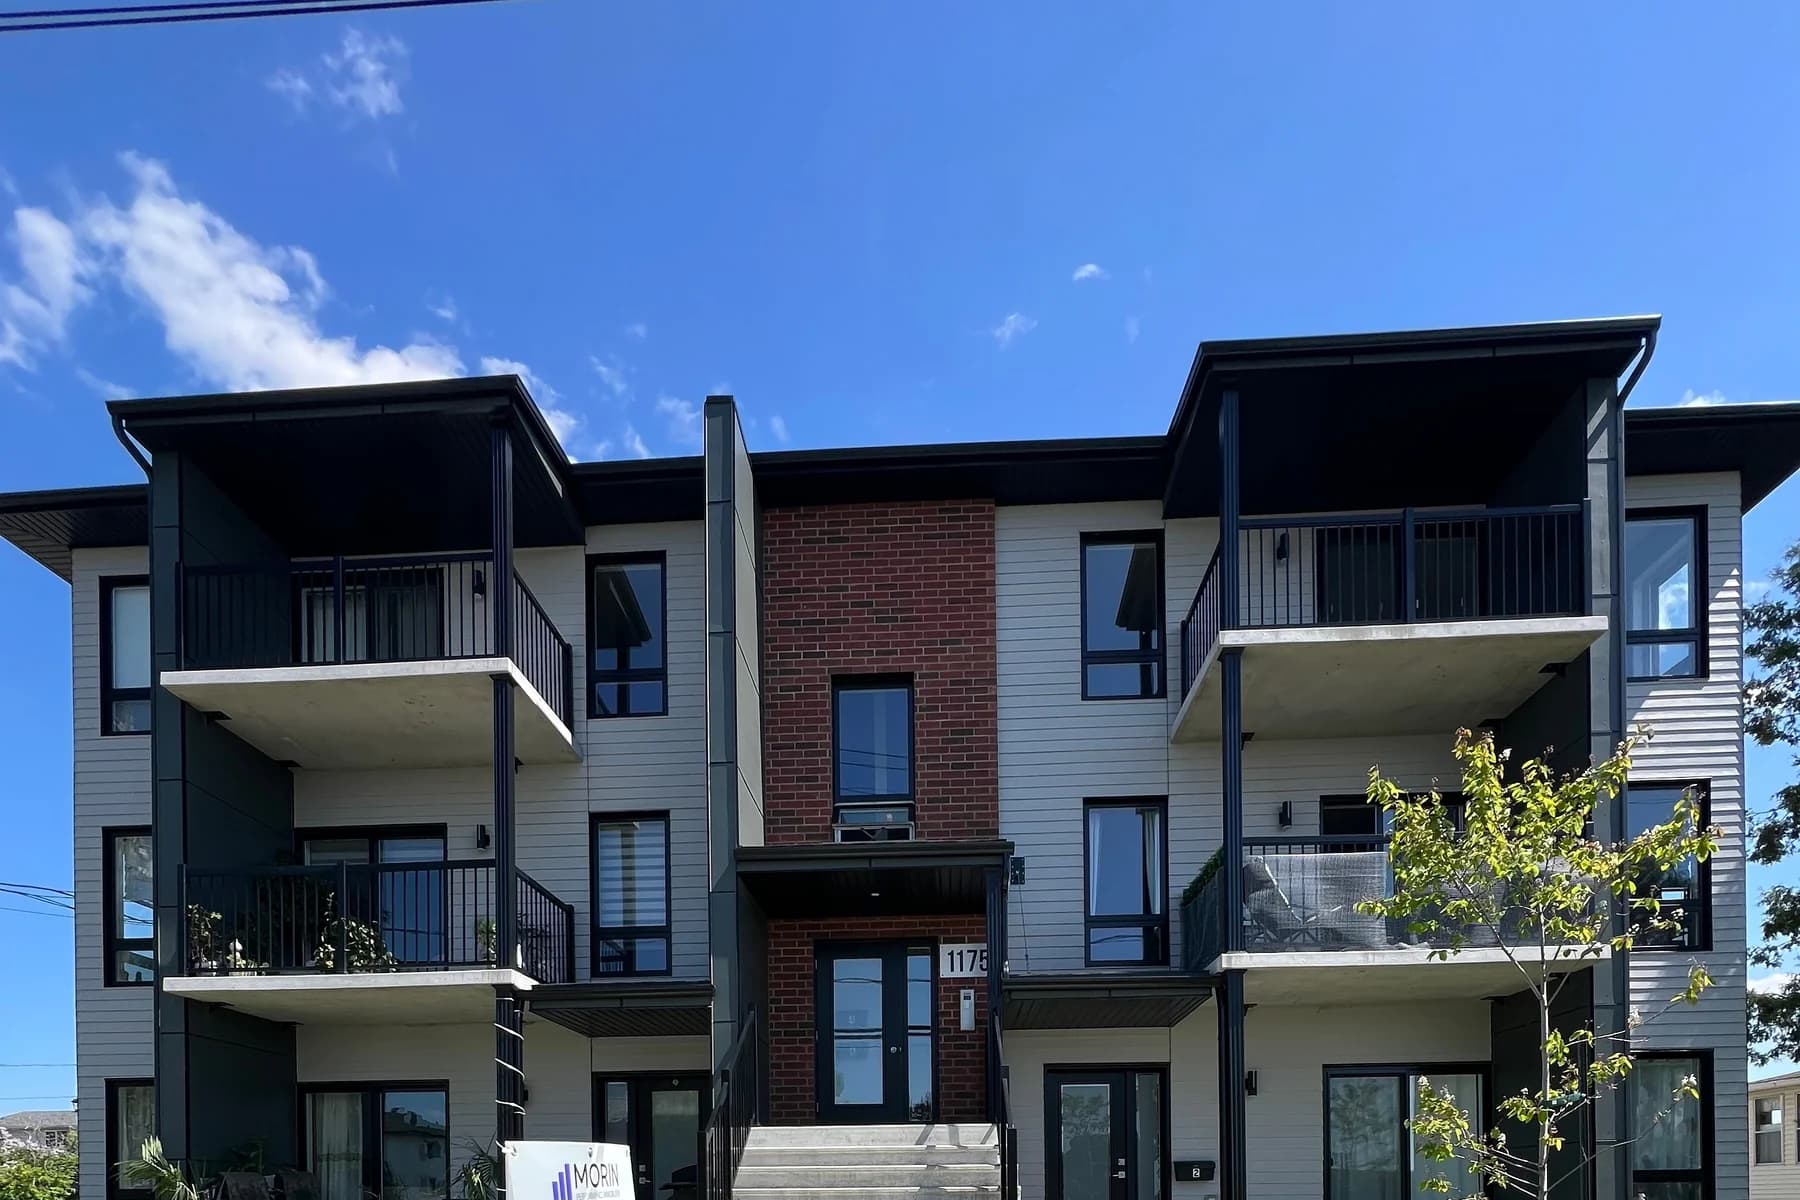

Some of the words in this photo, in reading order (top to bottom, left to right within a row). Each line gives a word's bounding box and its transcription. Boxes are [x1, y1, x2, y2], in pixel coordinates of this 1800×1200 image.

[947, 949, 988, 972] 1175
[573, 1163, 619, 1189] MORIN
[1193, 1169, 1200, 1177] 2
